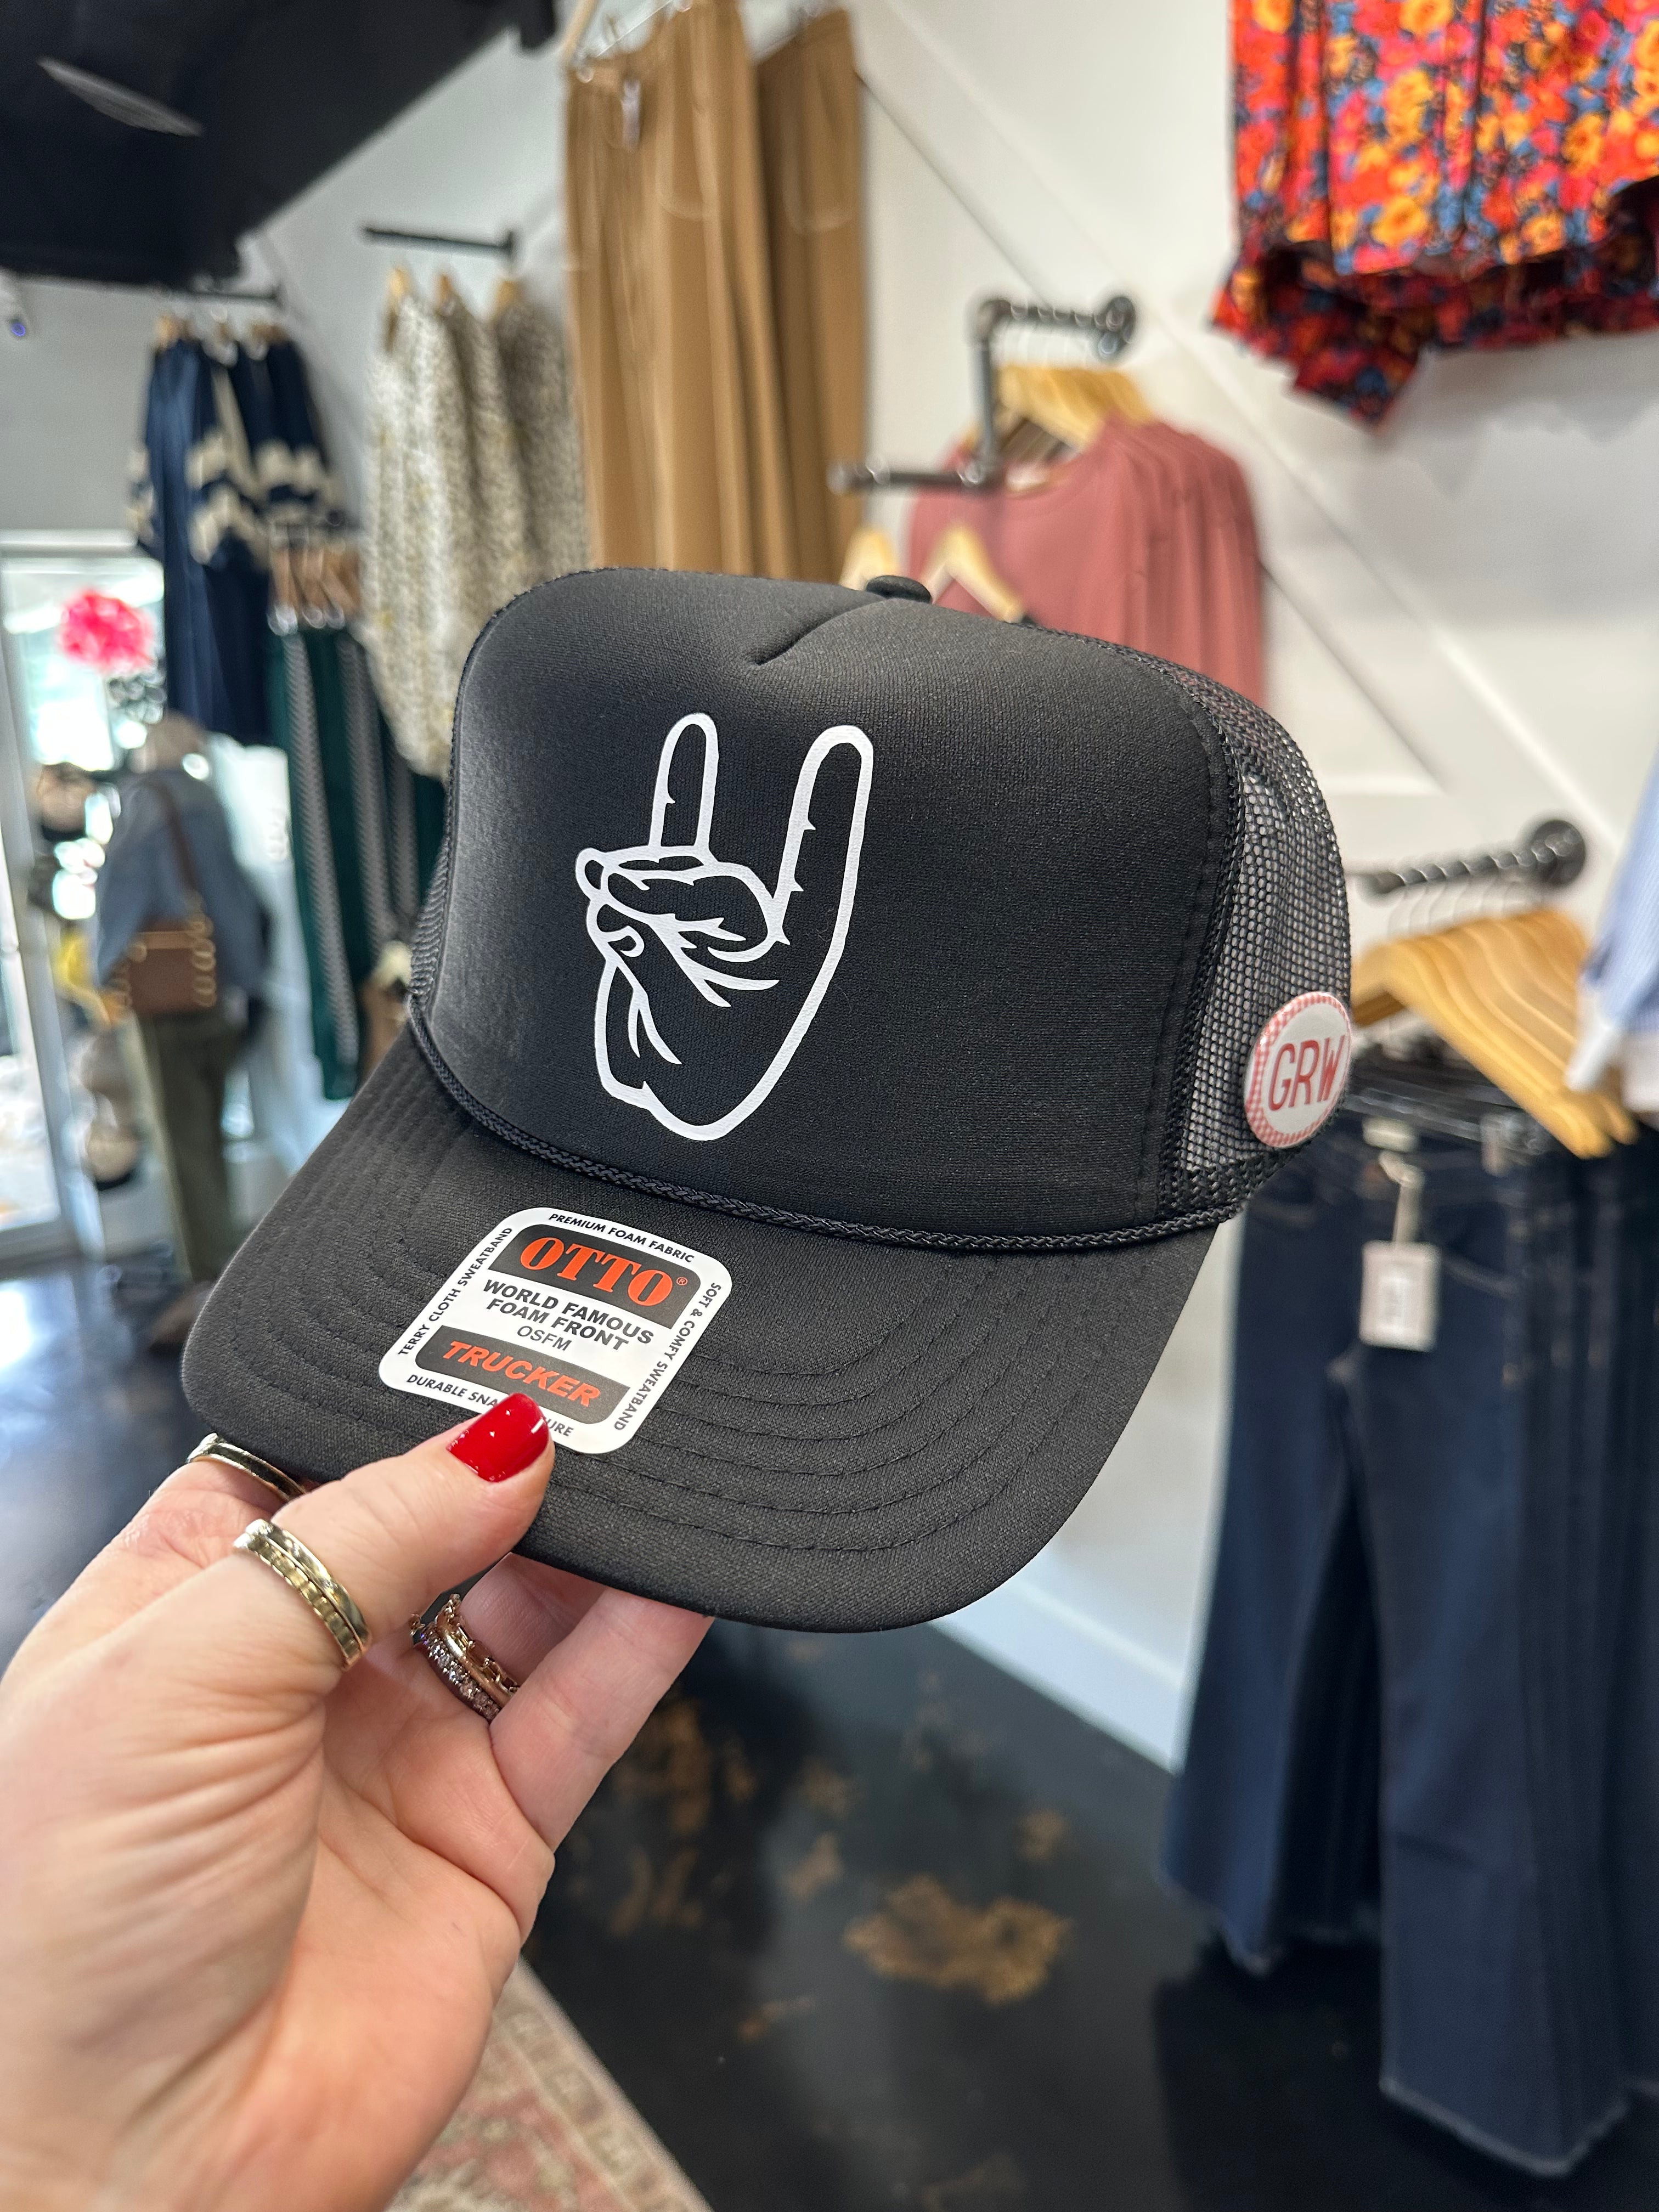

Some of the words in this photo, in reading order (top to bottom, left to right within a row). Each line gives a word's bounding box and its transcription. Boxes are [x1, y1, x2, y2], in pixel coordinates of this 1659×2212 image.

[1268, 1035, 1345, 1111] GRW
[549, 1213, 607, 1232] PREMIUM
[608, 1227, 647, 1245] FOAM
[648, 1240, 695, 1262] FABRIC
[398, 1323, 430, 1355] TERRY
[428, 1288, 461, 1322] CLOTH
[458, 1228, 513, 1286] SWEATBAND
[483, 1279, 558, 1310] WORLD
[561, 1302, 654, 1344] FAMOUS
[690, 1308, 703, 1317] &
[698, 1283, 721, 1308] SOFT
[486, 1298, 550, 1324] FOAM
[551, 1316, 629, 1351] FRONT
[517, 1325, 572, 1351] OSFM
[664, 1320, 695, 1361] COMFY
[407, 1374, 468, 1397] DURABLE
[468, 1392, 498, 1407] SNA
[442, 1340, 601, 1408] TRUCKER
[614, 1361, 668, 1430] SWEATBAND
